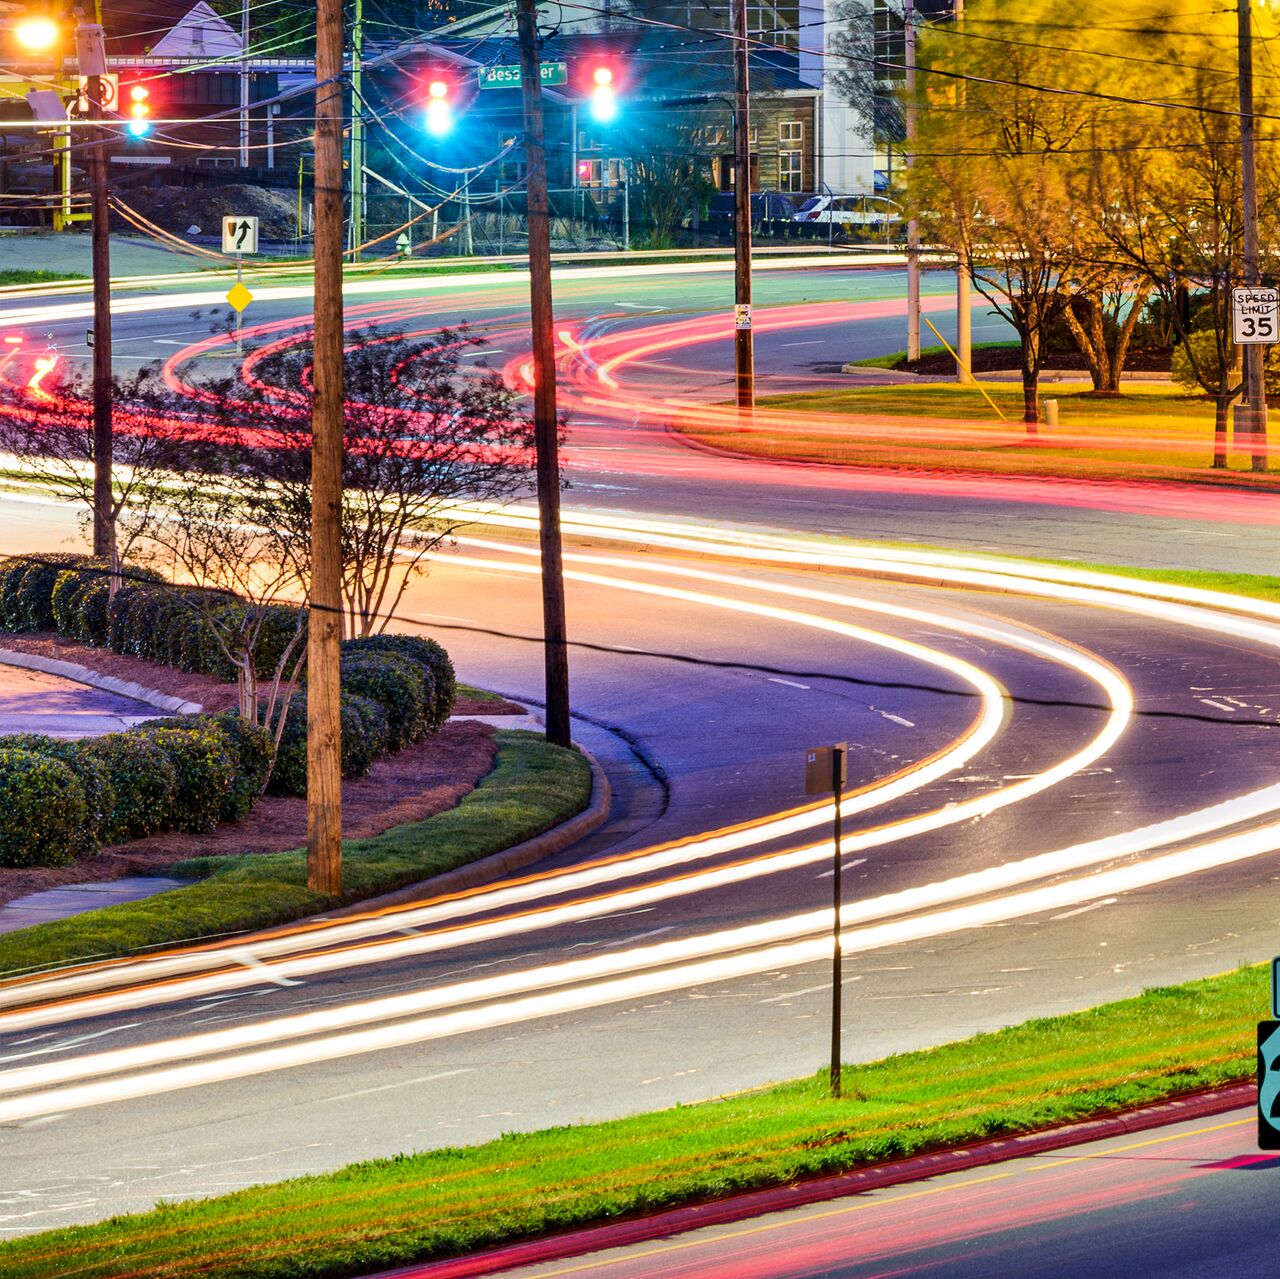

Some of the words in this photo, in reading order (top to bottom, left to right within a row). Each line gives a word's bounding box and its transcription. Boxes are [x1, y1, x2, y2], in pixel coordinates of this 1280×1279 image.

[487, 67, 553, 81] Besser
[1238, 294, 1275, 303] SPEED
[1241, 306, 1271, 315] LIMIT
[1241, 317, 1273, 337] 35
